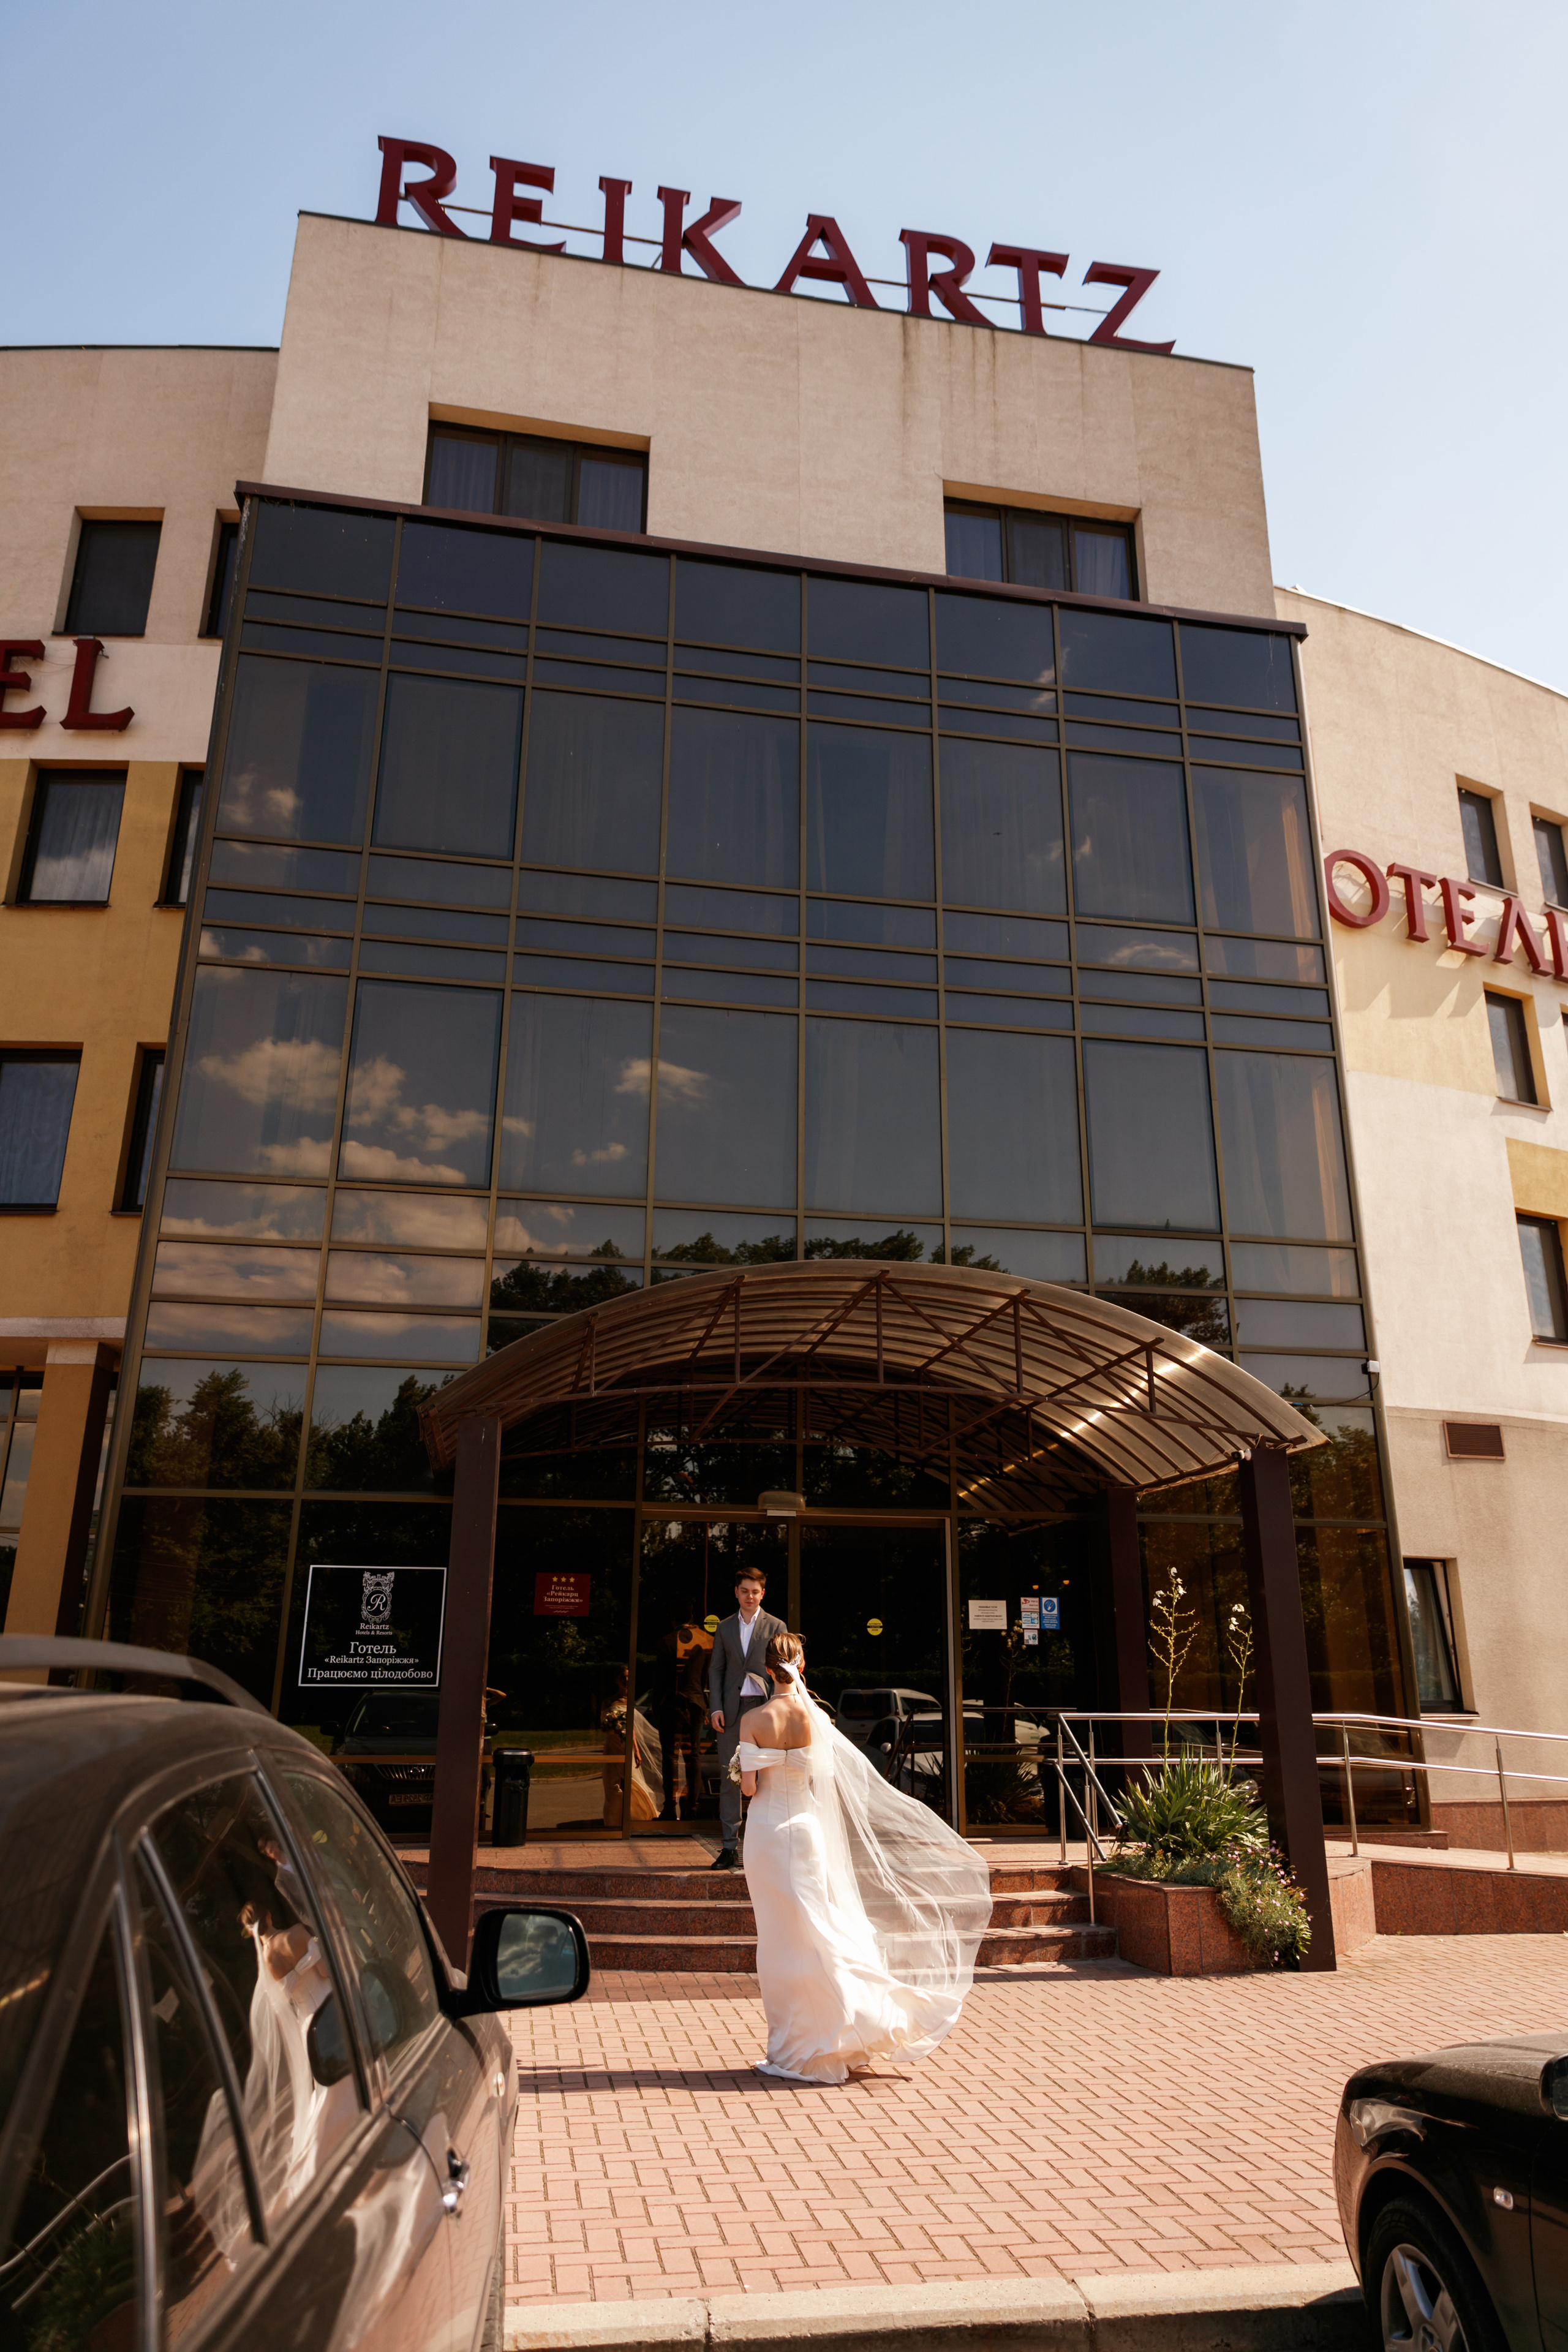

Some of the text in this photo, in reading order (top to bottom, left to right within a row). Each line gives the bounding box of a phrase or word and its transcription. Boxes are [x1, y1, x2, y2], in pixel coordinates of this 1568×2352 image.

[375, 135, 1177, 353] REIKARTZ
[349, 1642, 397, 1654] Готель
[366, 1656, 419, 1665] Запоріжжя»
[307, 1668, 433, 1680] Працюємо цілодобово
